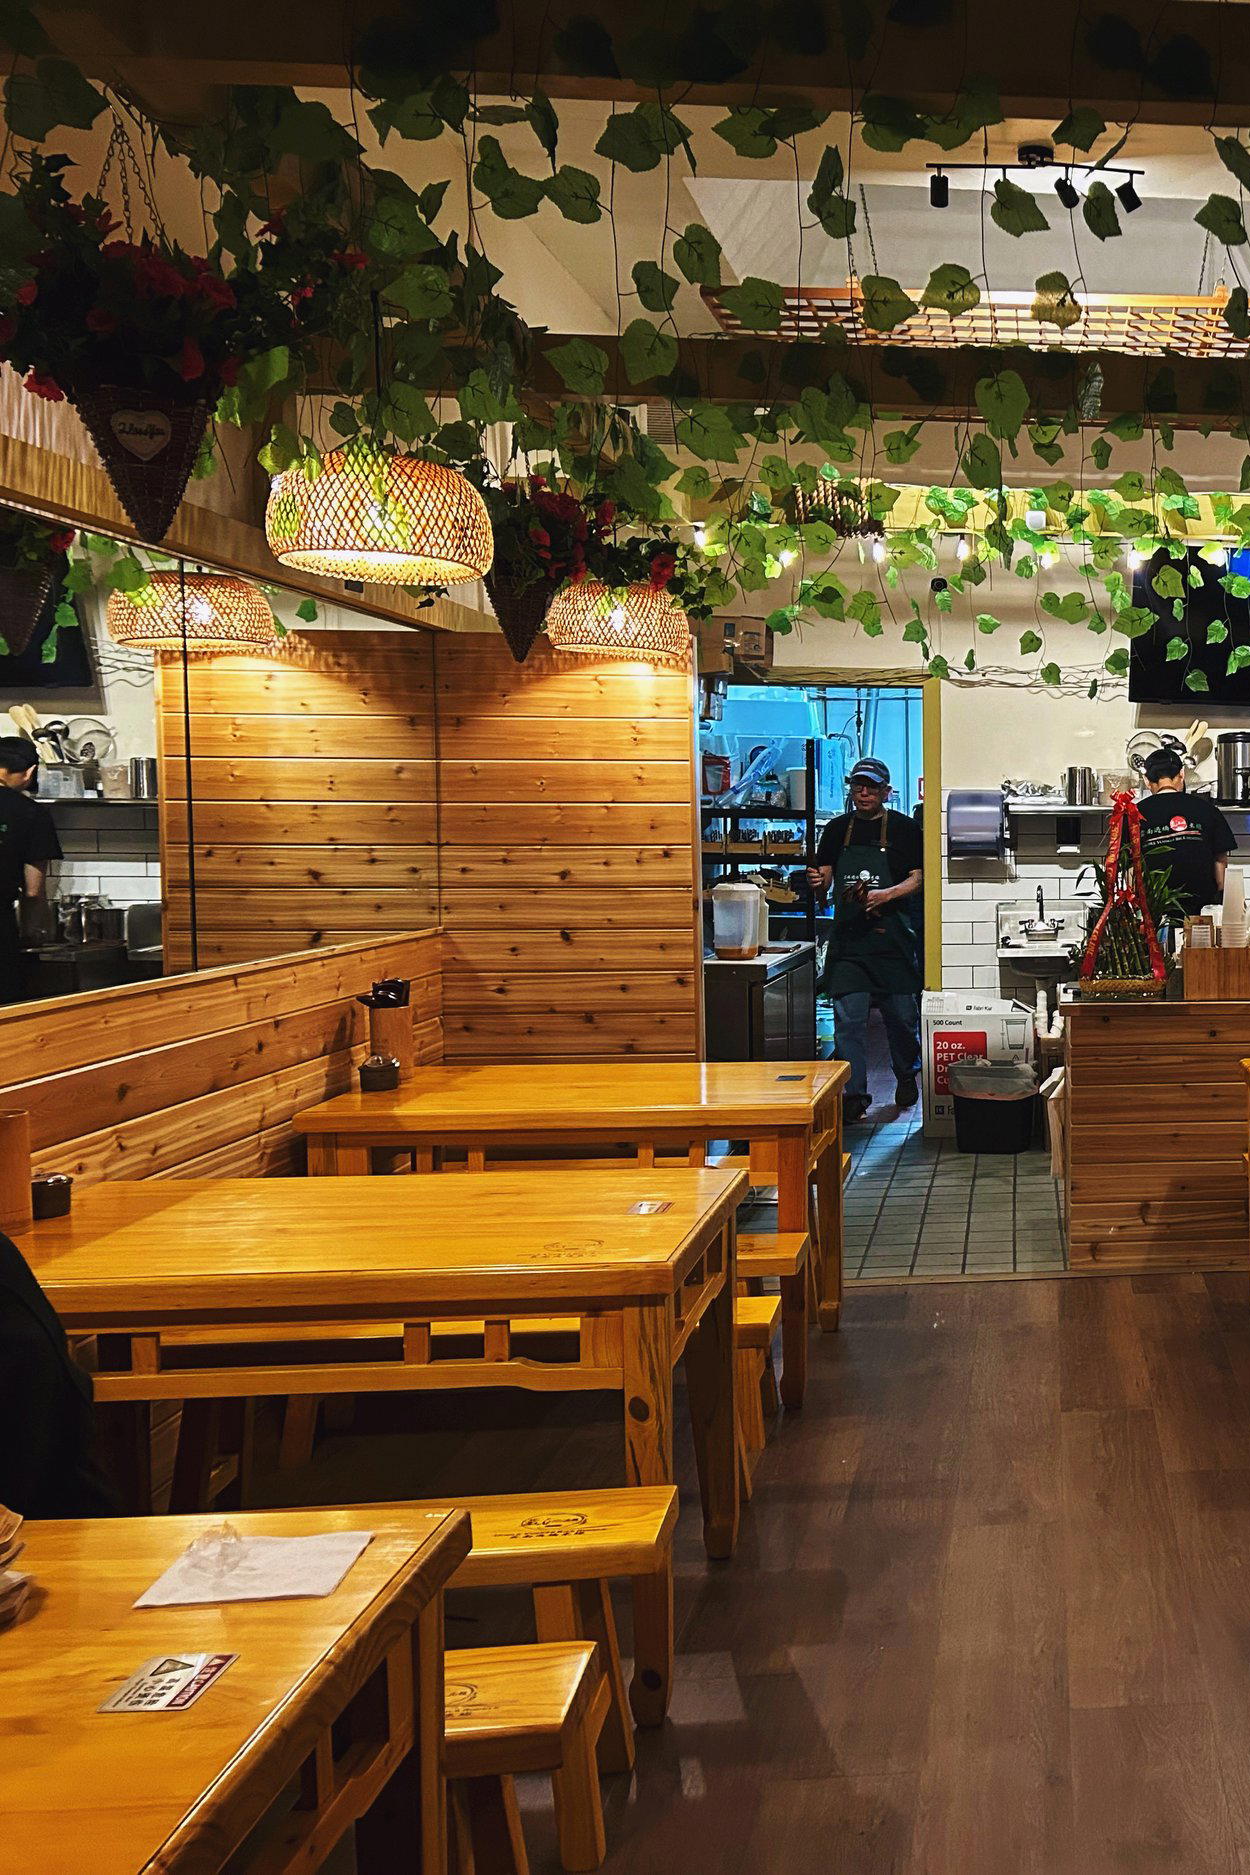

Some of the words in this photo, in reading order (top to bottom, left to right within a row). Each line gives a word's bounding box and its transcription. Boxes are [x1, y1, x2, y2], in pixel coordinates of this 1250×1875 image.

[936, 1041, 949, 1050] 20
[936, 1053, 955, 1061] PET
[957, 1053, 983, 1061] Clear
